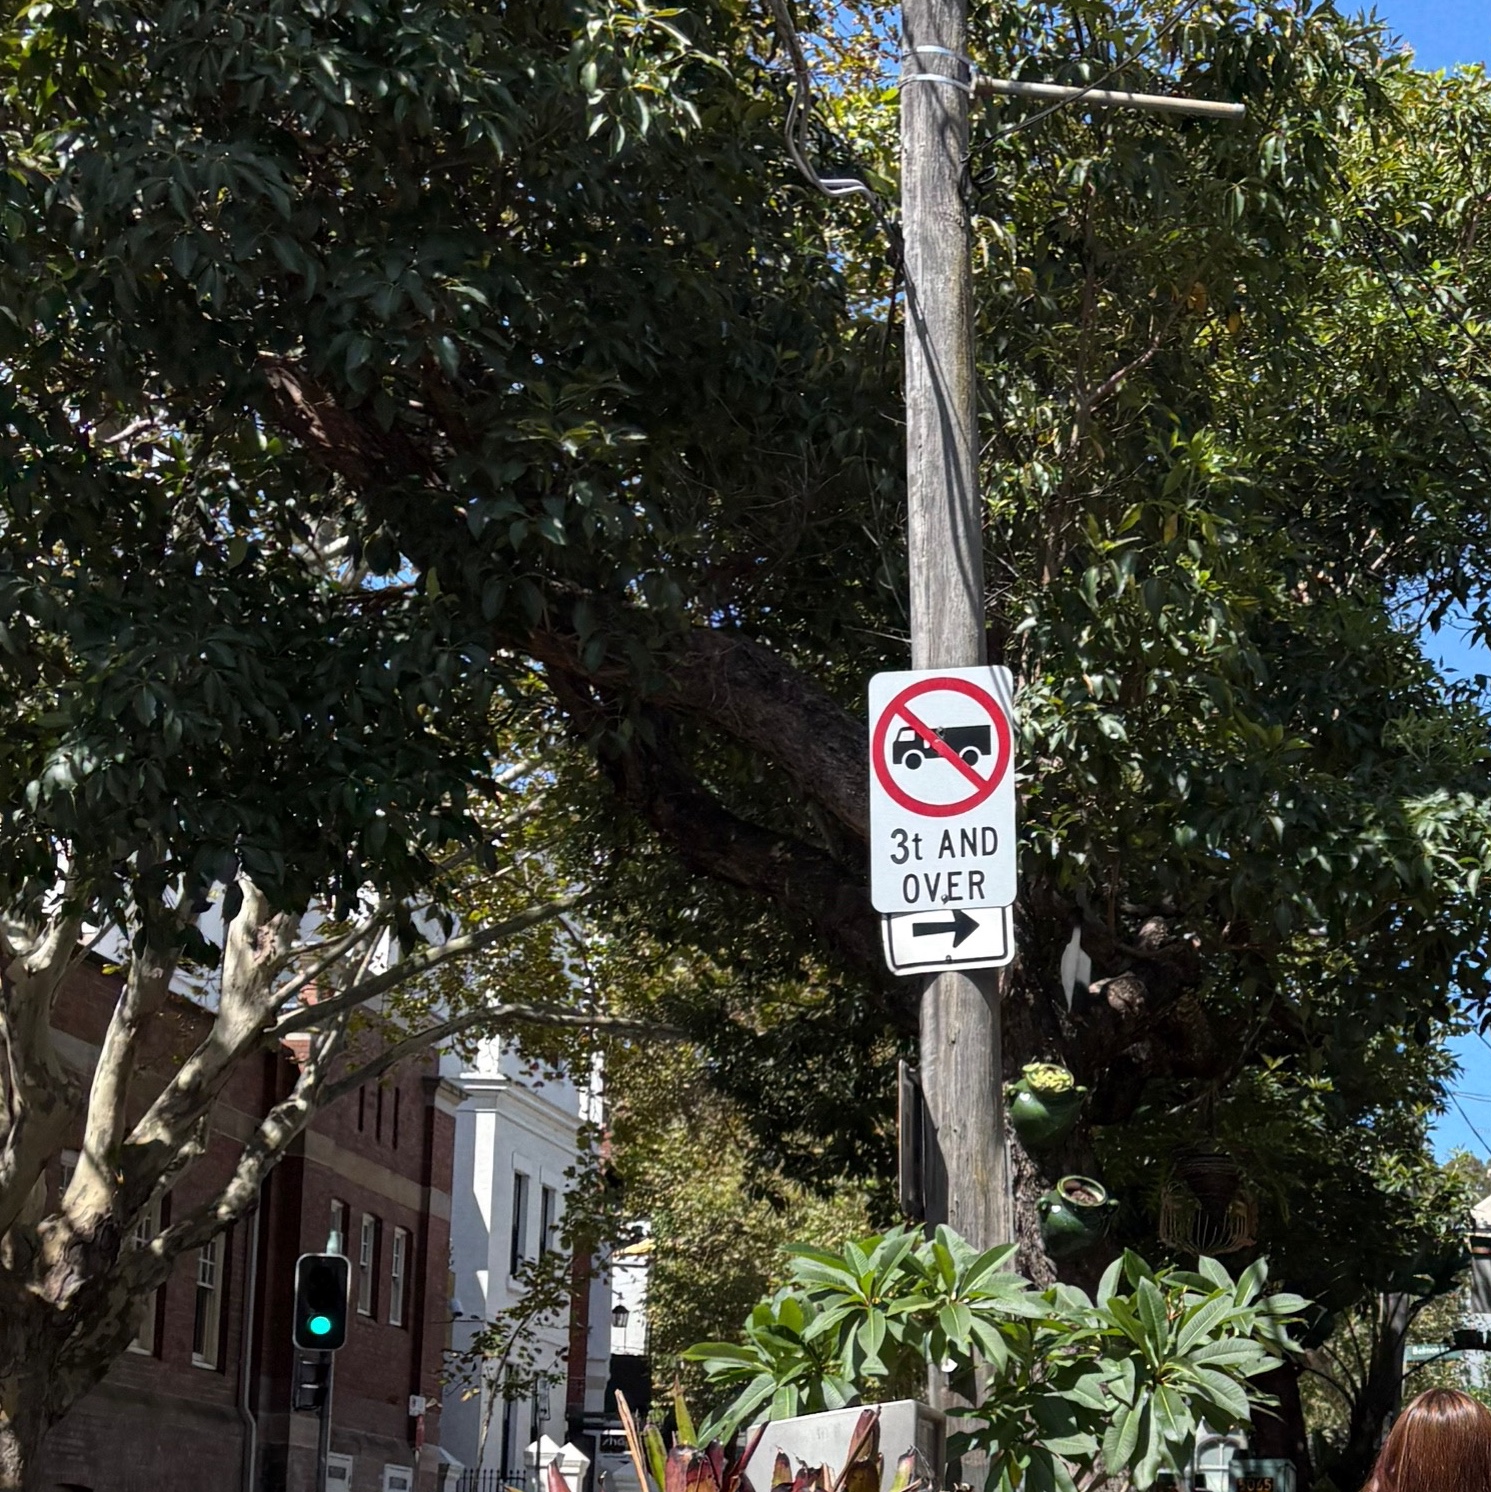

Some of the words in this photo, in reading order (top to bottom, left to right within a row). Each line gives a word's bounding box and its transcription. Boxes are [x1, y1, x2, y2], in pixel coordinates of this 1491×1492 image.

[890, 828, 923, 865] 3t
[938, 826, 998, 859] AND
[903, 870, 985, 904] OVER
